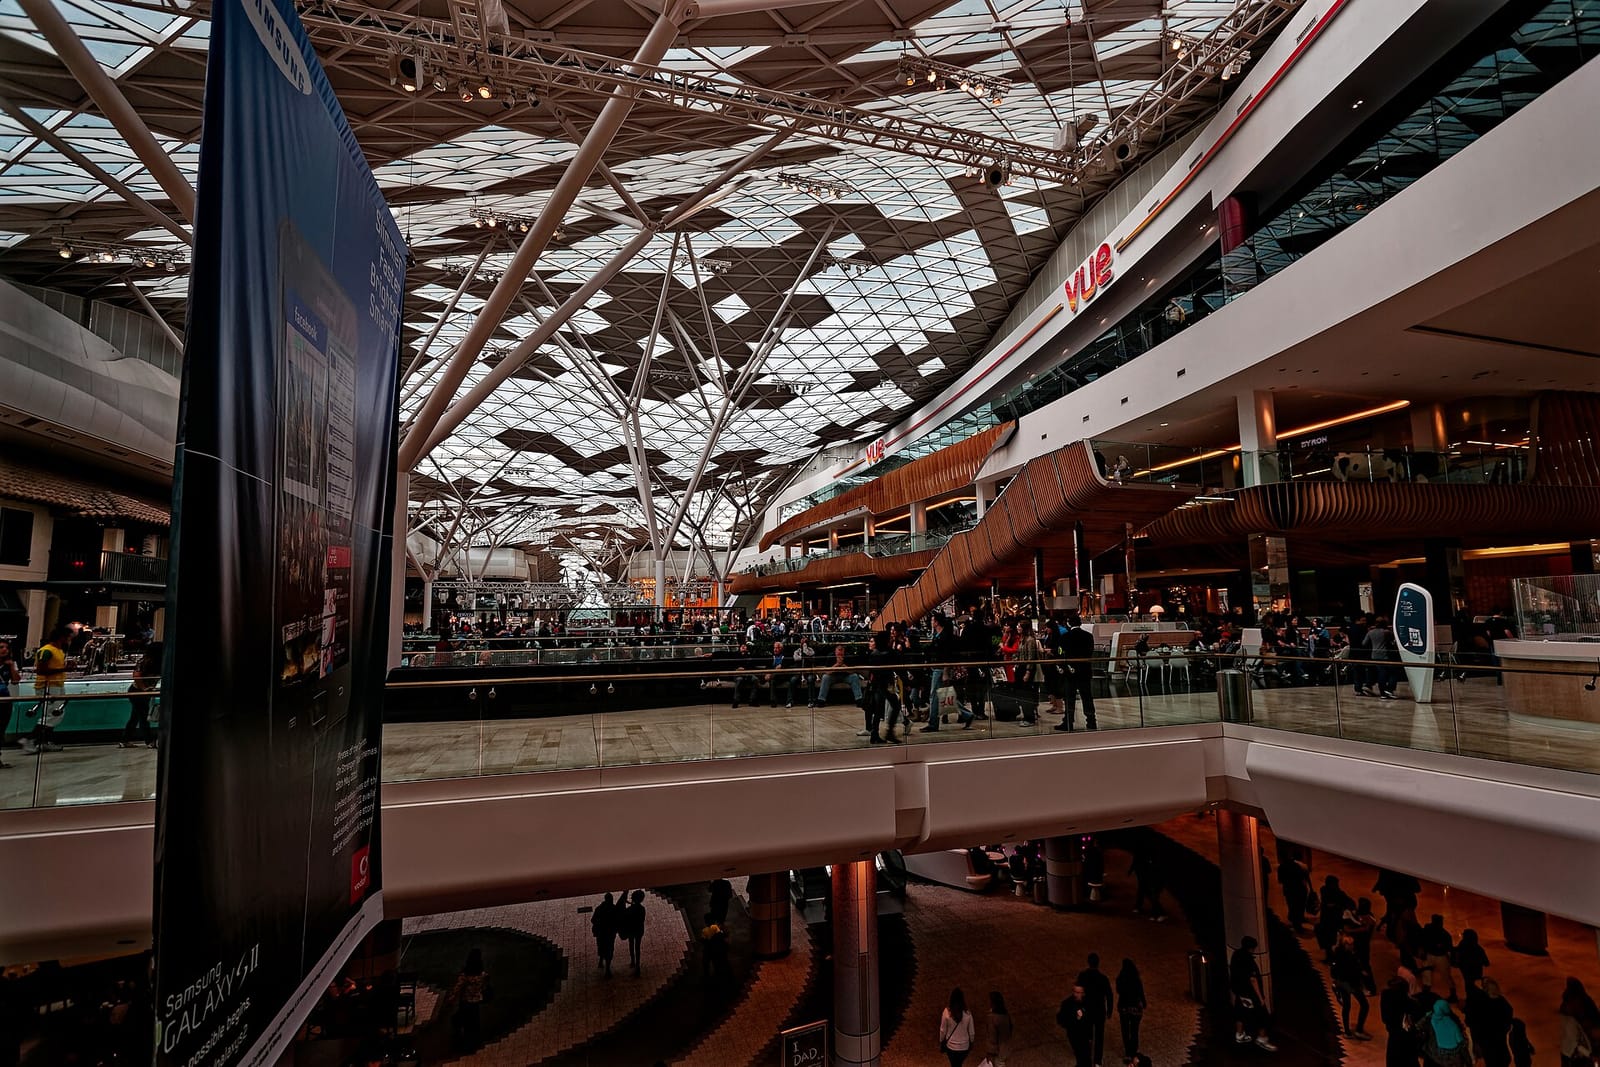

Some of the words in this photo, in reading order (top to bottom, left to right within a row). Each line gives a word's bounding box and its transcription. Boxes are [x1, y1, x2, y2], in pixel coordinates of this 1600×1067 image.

[375, 208, 402, 272] Slimmer
[370, 261, 402, 321] Brighter
[379, 246, 401, 294] Faster
[294, 305, 318, 342] facebook
[163, 967, 236, 1055] GALAXY
[165, 961, 223, 1018] Samsung
